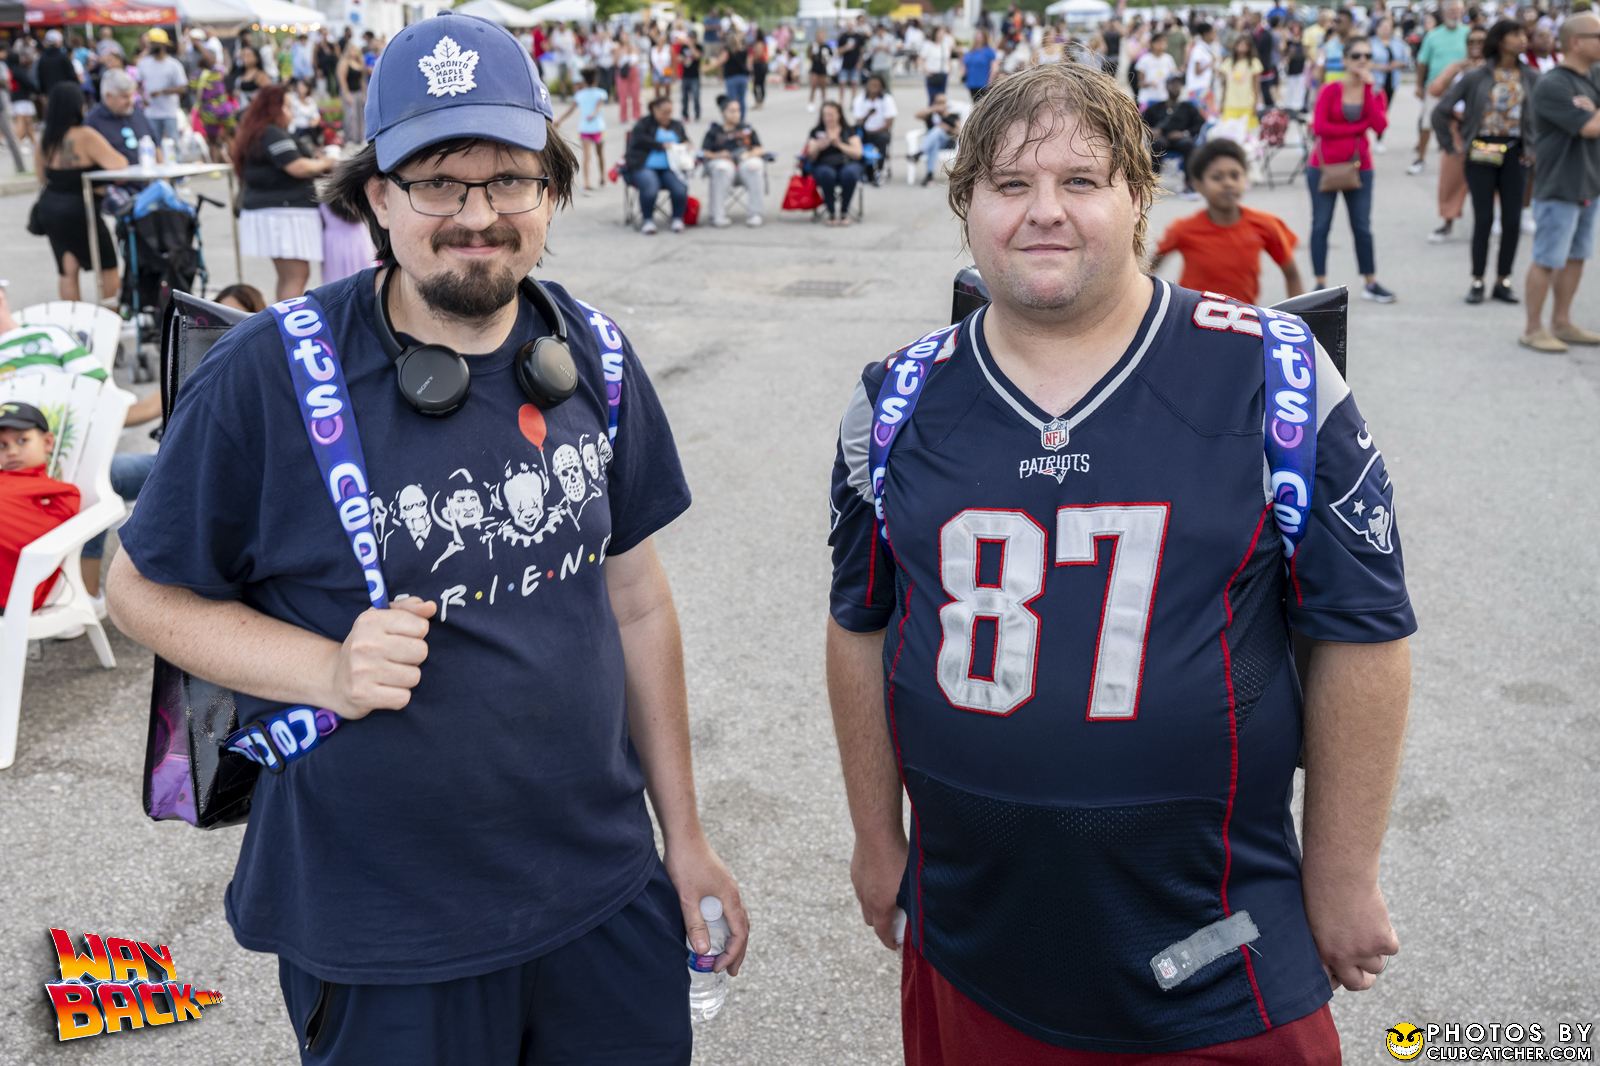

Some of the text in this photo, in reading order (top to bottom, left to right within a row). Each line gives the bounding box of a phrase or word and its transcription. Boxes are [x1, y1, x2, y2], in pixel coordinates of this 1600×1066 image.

[430, 60, 469, 73] TORONTO
[435, 68, 463, 77] MAPLE
[437, 75, 464, 84] LEAFS
[416, 375, 433, 395] SONY
[1045, 431, 1065, 446] NFL
[1019, 454, 1090, 479] PATRIOTS
[937, 502, 1171, 721] 87
